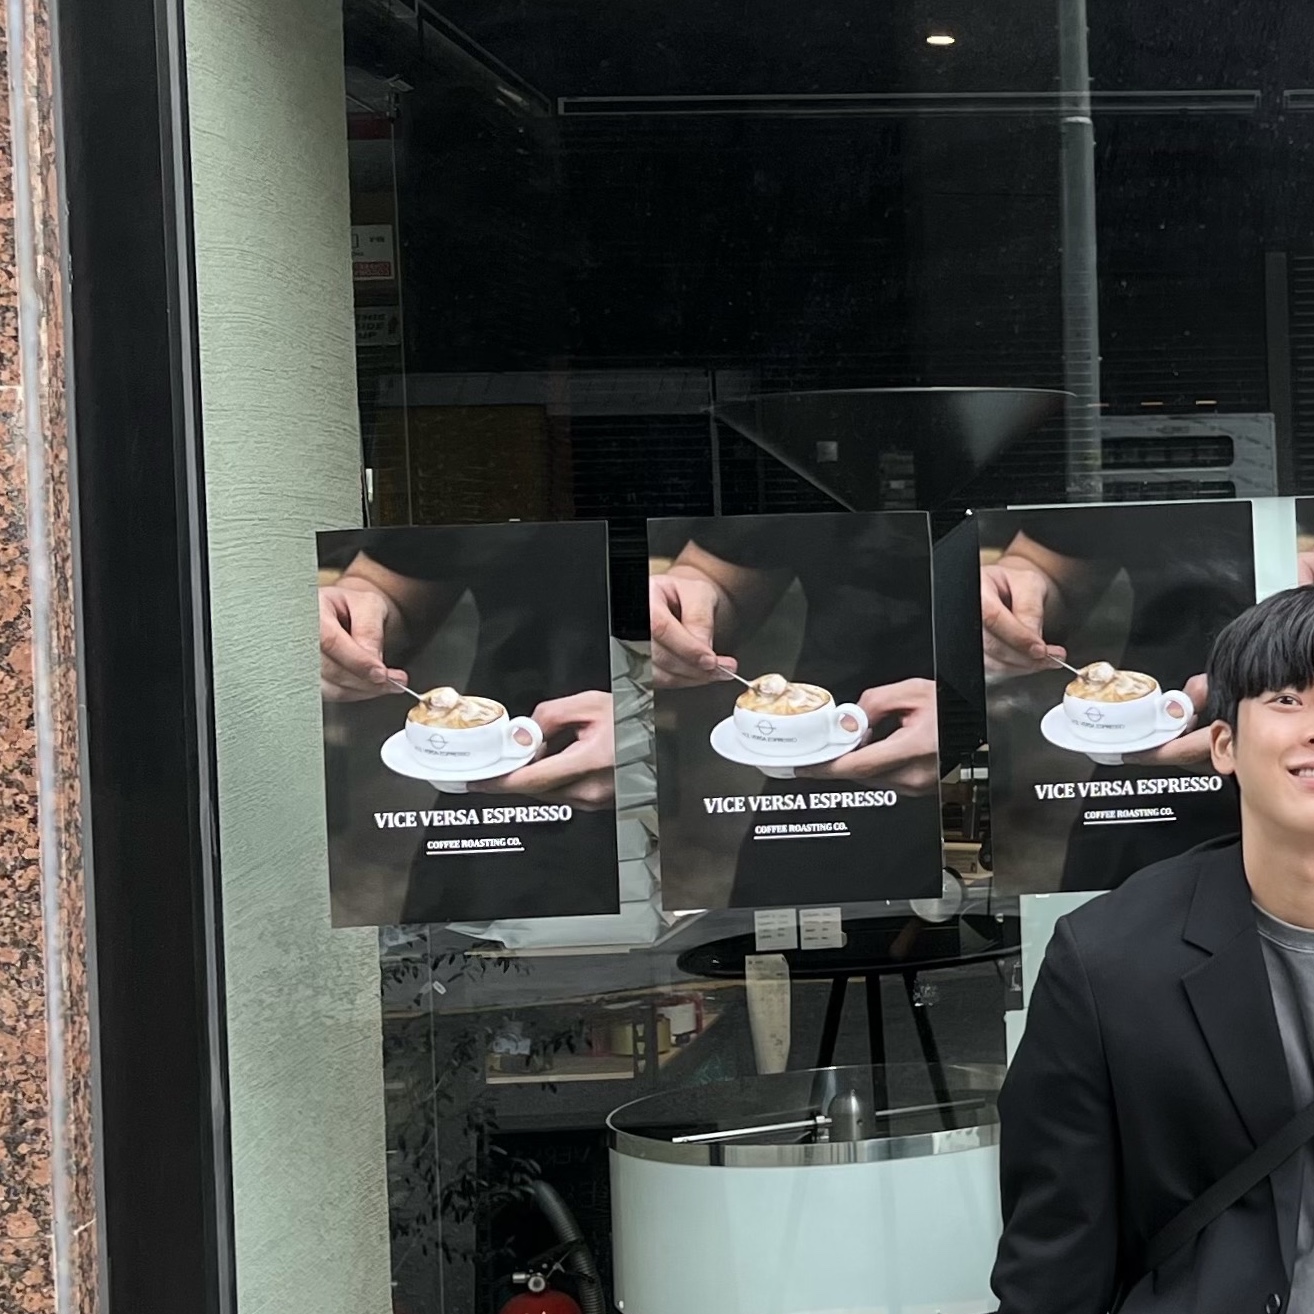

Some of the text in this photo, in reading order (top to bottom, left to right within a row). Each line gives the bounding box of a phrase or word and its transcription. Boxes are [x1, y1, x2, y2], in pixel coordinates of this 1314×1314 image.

[1034, 776, 1223, 800] VICE VERSA ESPRESSO
[703, 790, 898, 814] VICE VERSA ESPRESSO
[374, 805, 573, 828] VICE VERSA ESPRESSO
[1083, 807, 1174, 820] COFFEE ROASTING CO.
[755, 821, 848, 834] COFFEE ROASTING CO.
[427, 837, 522, 849] COFFEE ROASTING CO.
